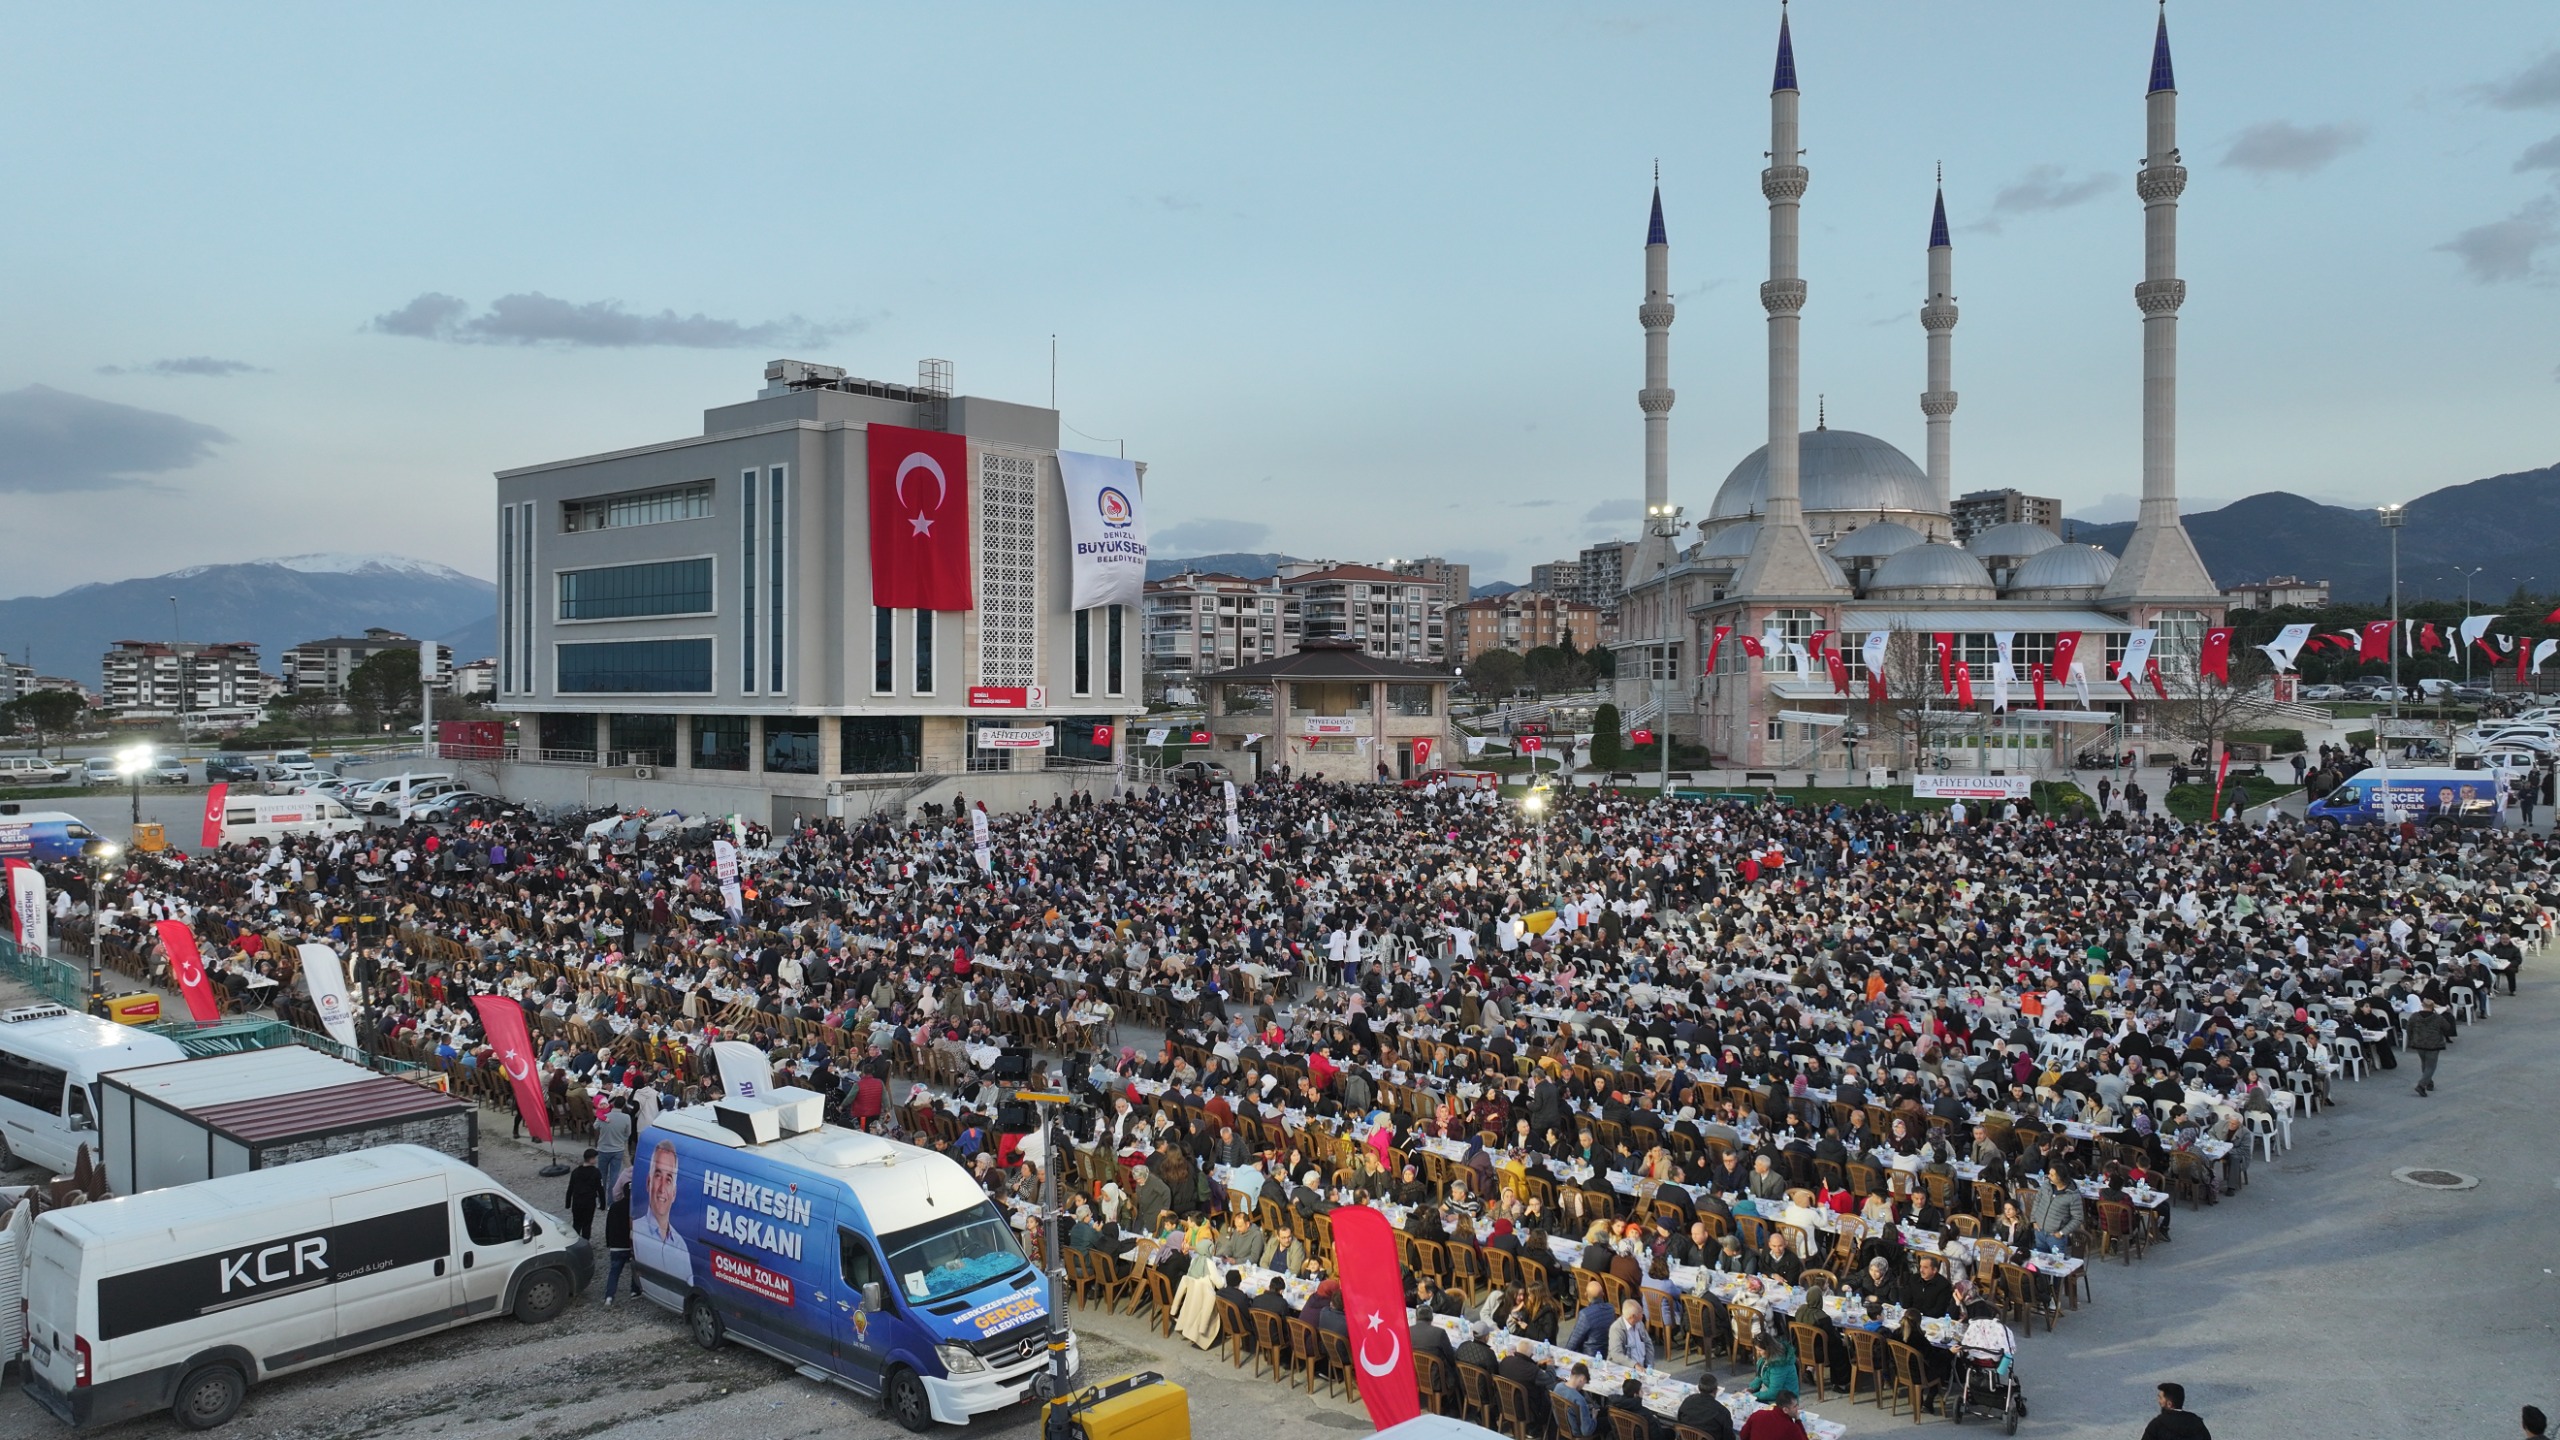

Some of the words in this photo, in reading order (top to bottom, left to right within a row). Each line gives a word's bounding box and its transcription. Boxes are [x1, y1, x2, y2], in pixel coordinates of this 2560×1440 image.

[1077, 540, 1147, 556] BÜYÜKŞEHİ
[1931, 776, 1969, 787] AFİYET
[1972, 779, 2012, 788] OLSUN
[2372, 793, 2424, 803] GRÇEK
[703, 1169, 811, 1227] HERKESİN
[706, 1205, 802, 1261] BAŞKANI
[220, 1236, 329, 1294] KCR
[337, 1266, 364, 1280] Sound
[372, 1259, 394, 1272] Light
[715, 1255, 752, 1279] OSMAN
[755, 1268, 789, 1293] ZOLAN
[974, 1297, 1041, 1329] GERÇEK
